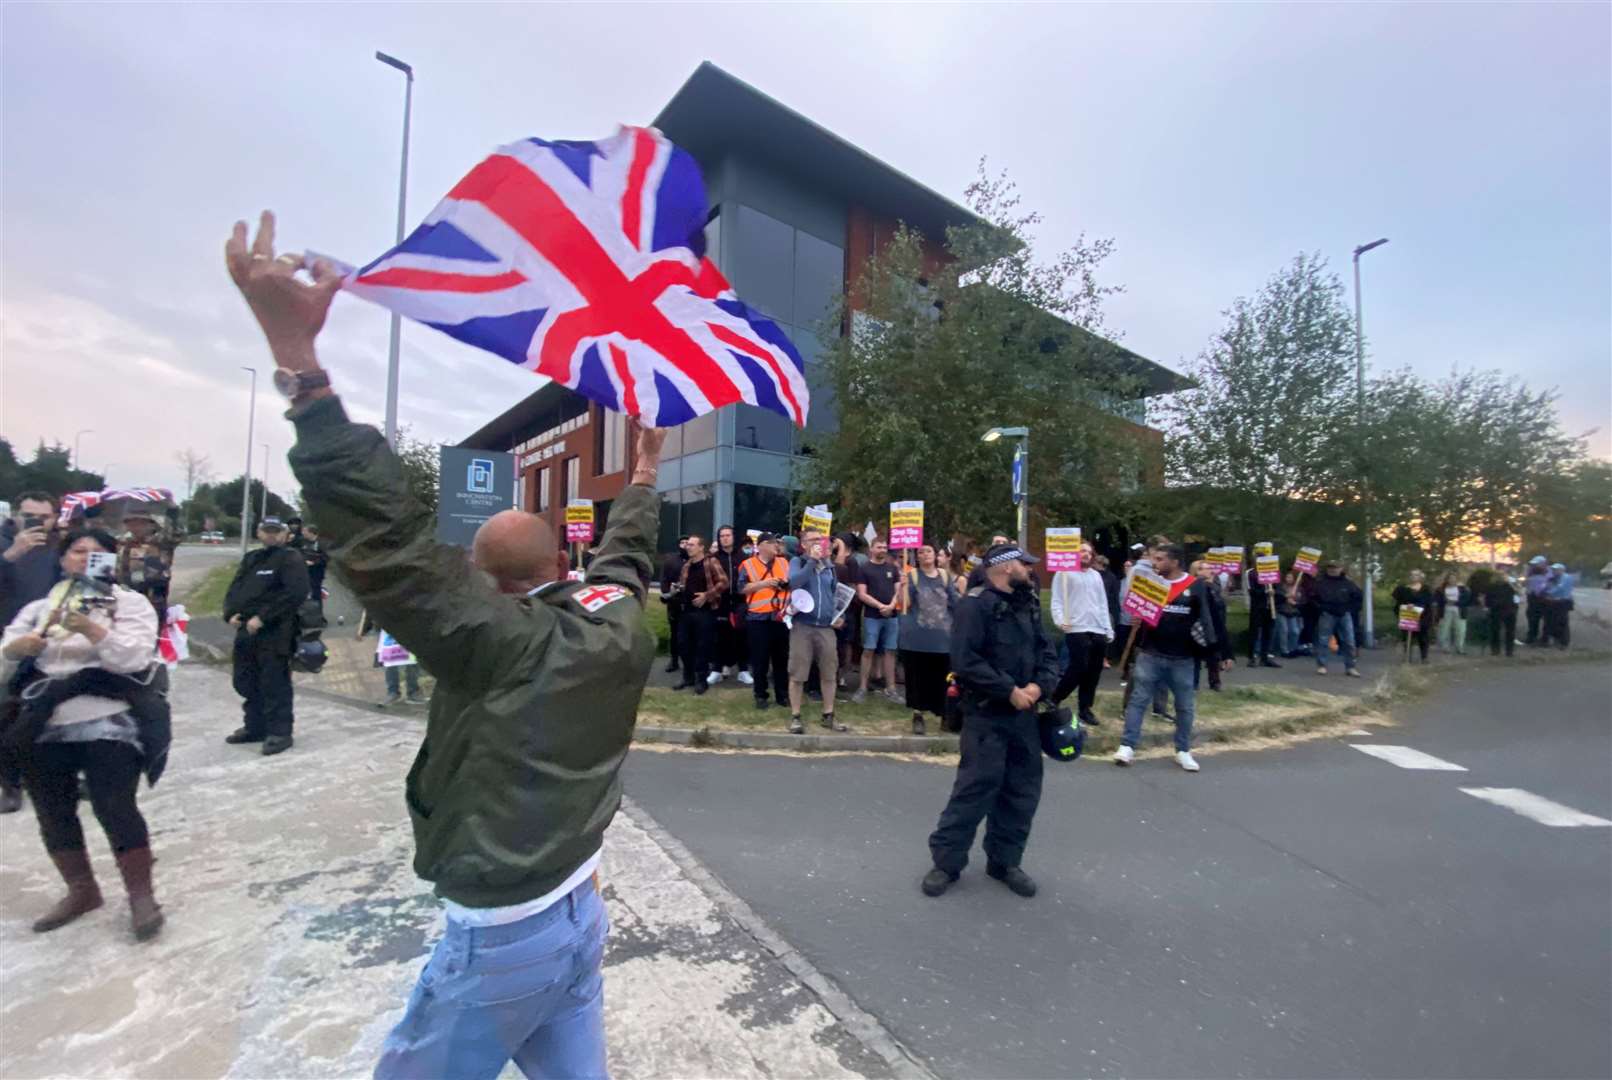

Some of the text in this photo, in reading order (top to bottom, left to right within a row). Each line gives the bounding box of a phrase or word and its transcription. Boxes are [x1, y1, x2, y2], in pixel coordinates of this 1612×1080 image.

[891, 527, 919, 537] Stop the
[901, 536, 918, 545] right
[1047, 552, 1063, 561] Stop
[1059, 560, 1076, 569] right
[1128, 591, 1146, 607] Stop
[1144, 601, 1159, 613] the
[1136, 606, 1156, 620] right
